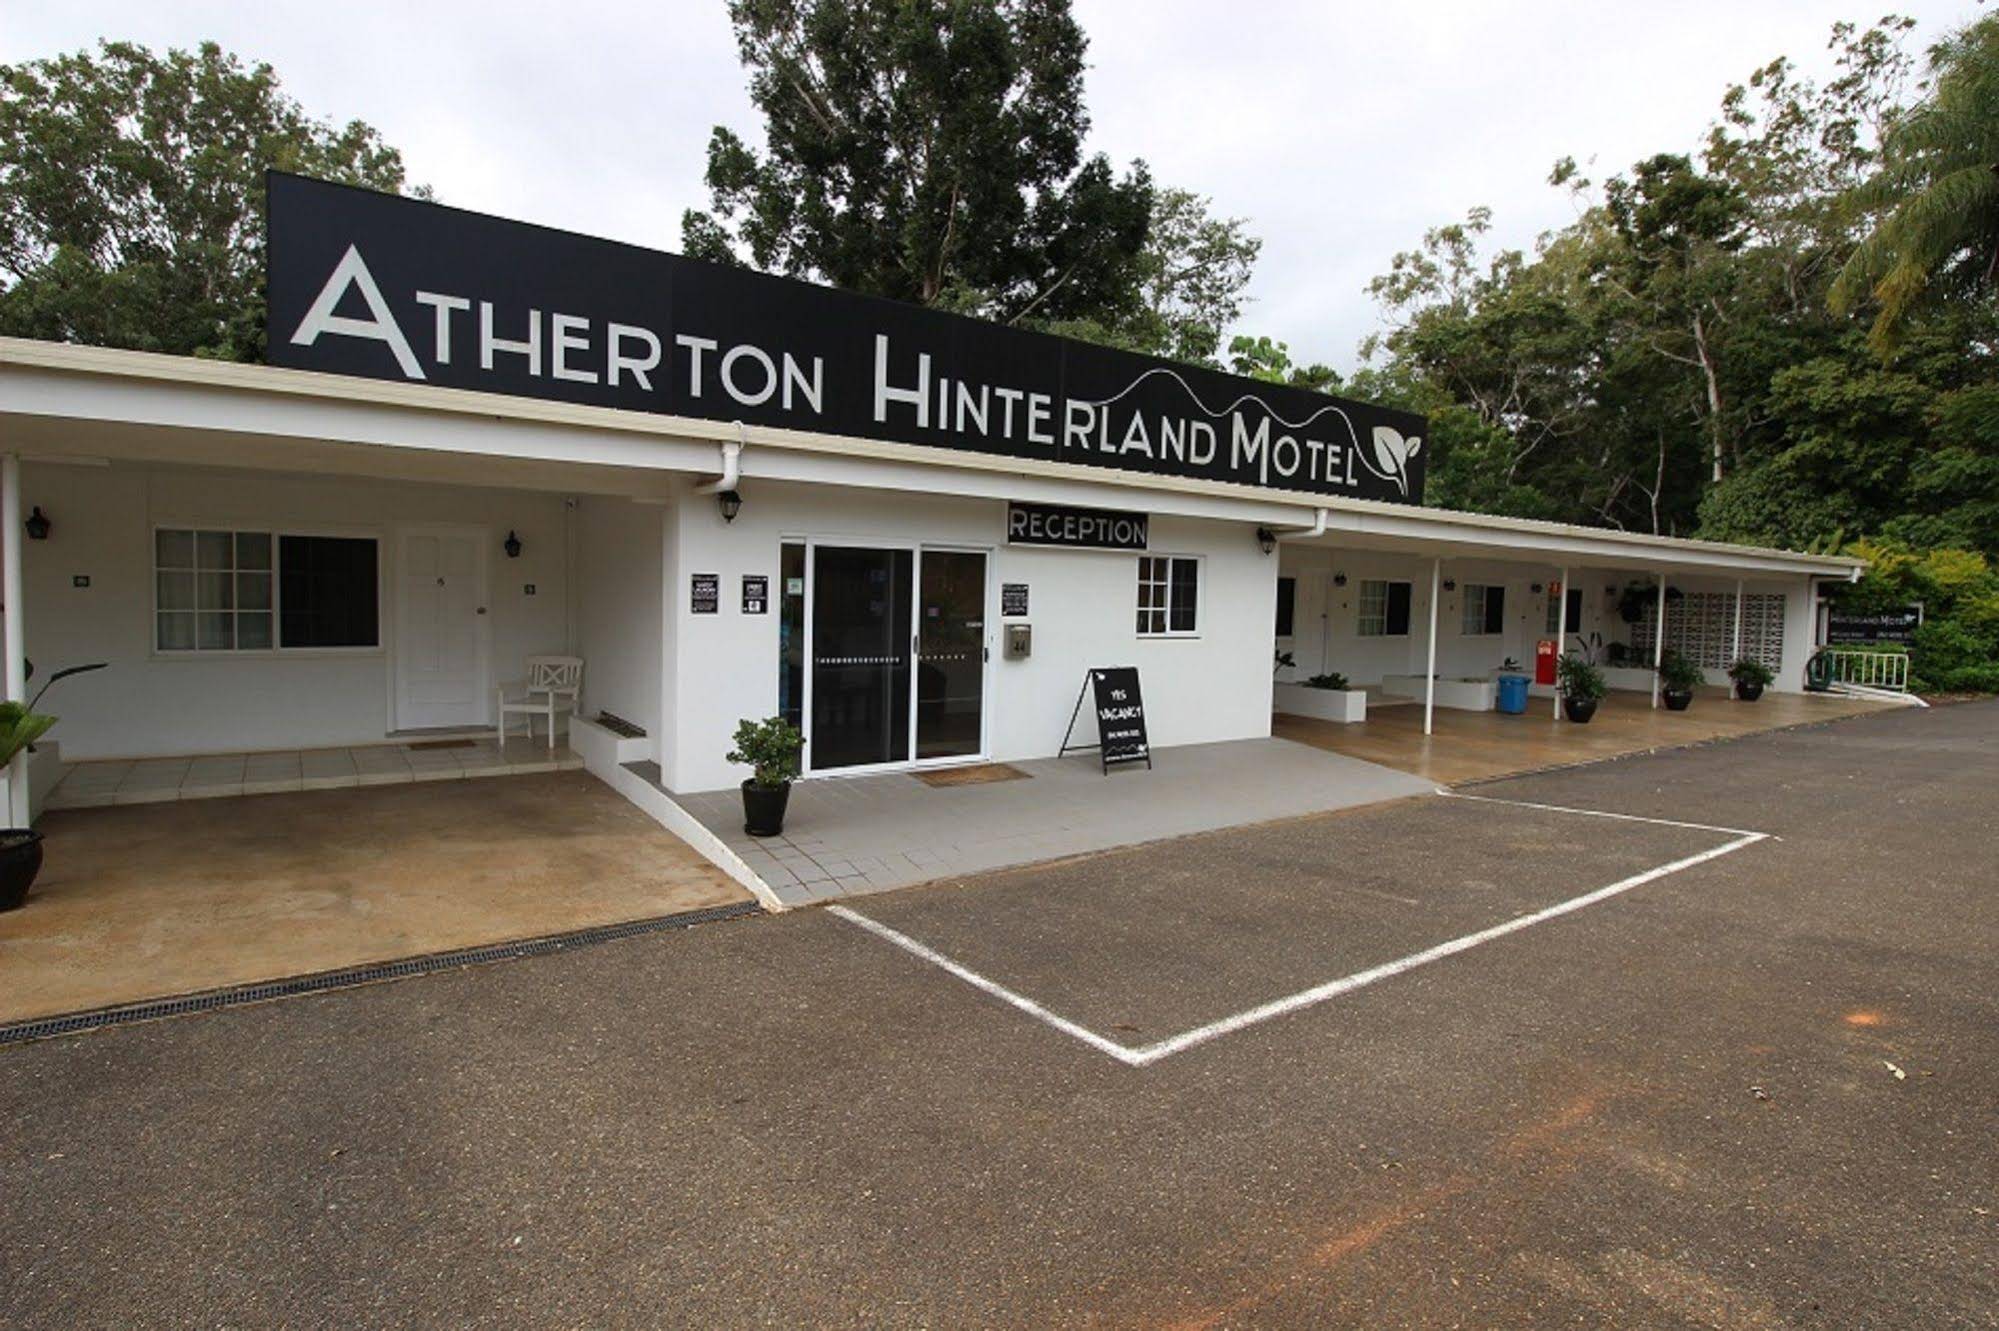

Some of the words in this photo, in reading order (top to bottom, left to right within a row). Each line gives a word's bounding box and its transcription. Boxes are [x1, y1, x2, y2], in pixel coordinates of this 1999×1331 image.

[290, 243, 824, 413] ATHERTON
[874, 334, 1217, 466] HINTERLAND
[1230, 411, 1358, 487] MOTEL
[1009, 508, 1146, 543] RECEPTION
